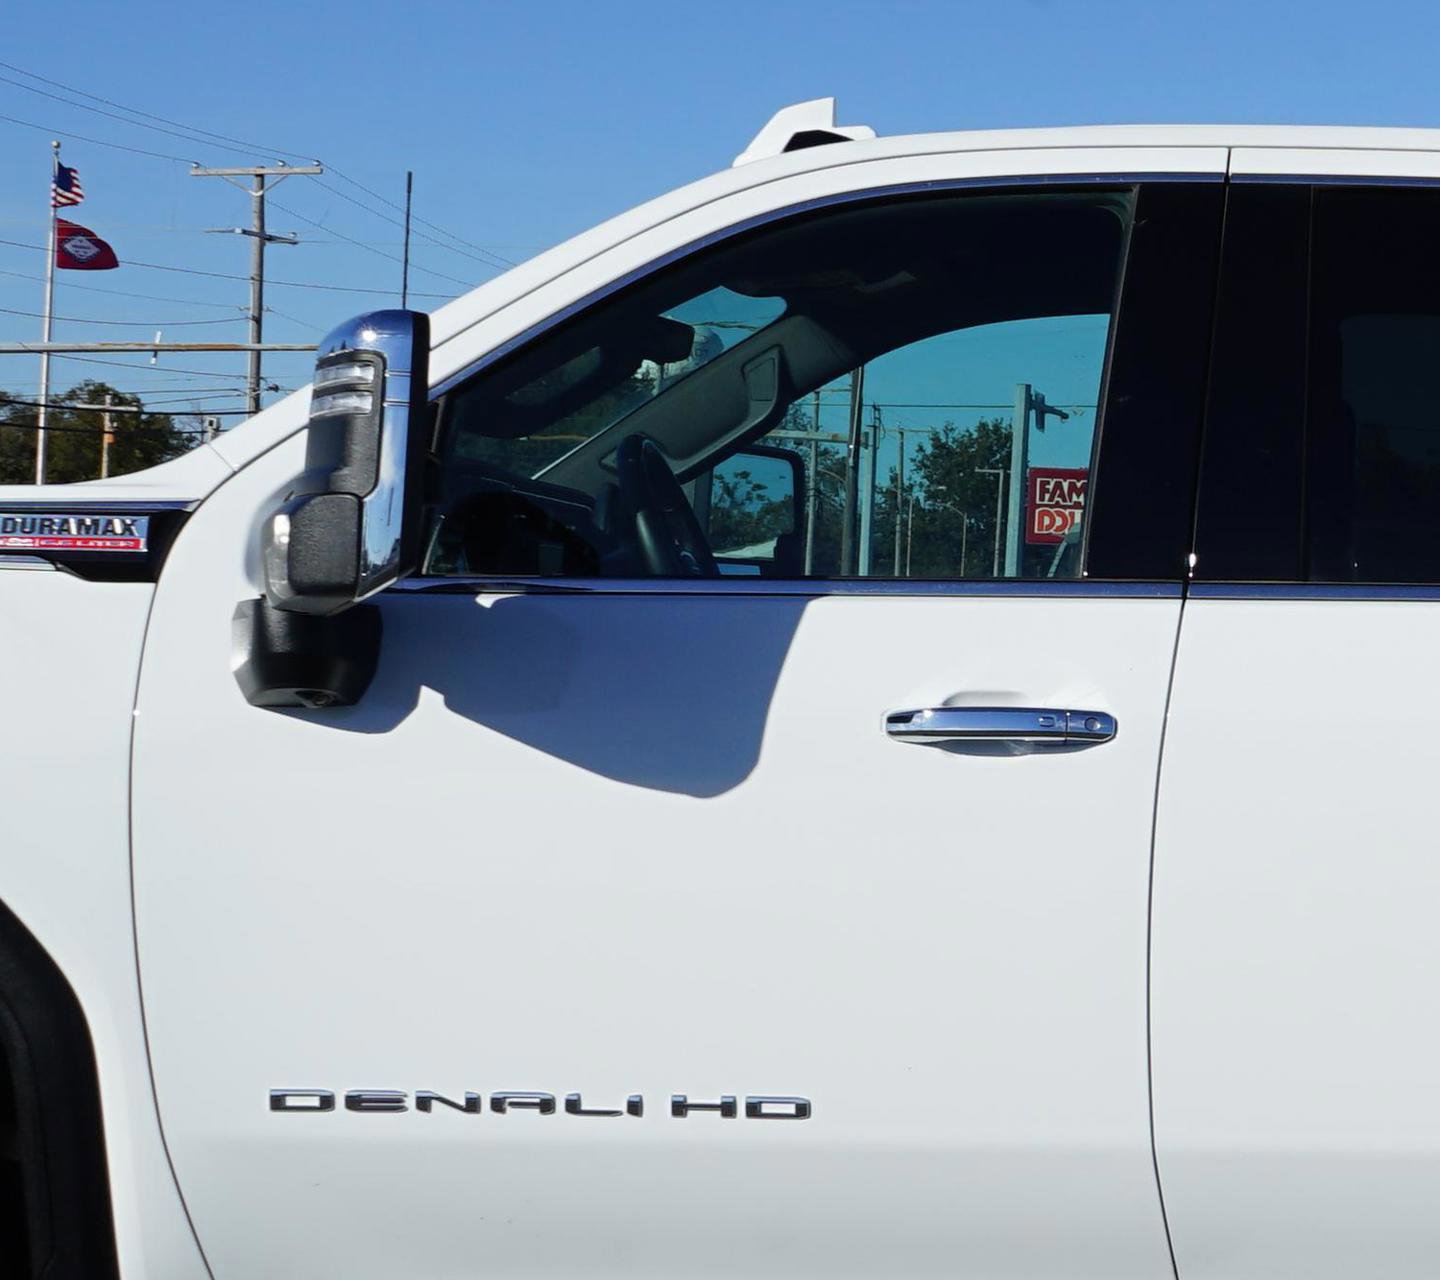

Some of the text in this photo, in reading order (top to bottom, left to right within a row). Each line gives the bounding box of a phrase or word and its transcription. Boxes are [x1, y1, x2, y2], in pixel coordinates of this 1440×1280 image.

[0, 516, 139, 537] DURAMAX
[268, 1088, 813, 1120] DENALI HD
